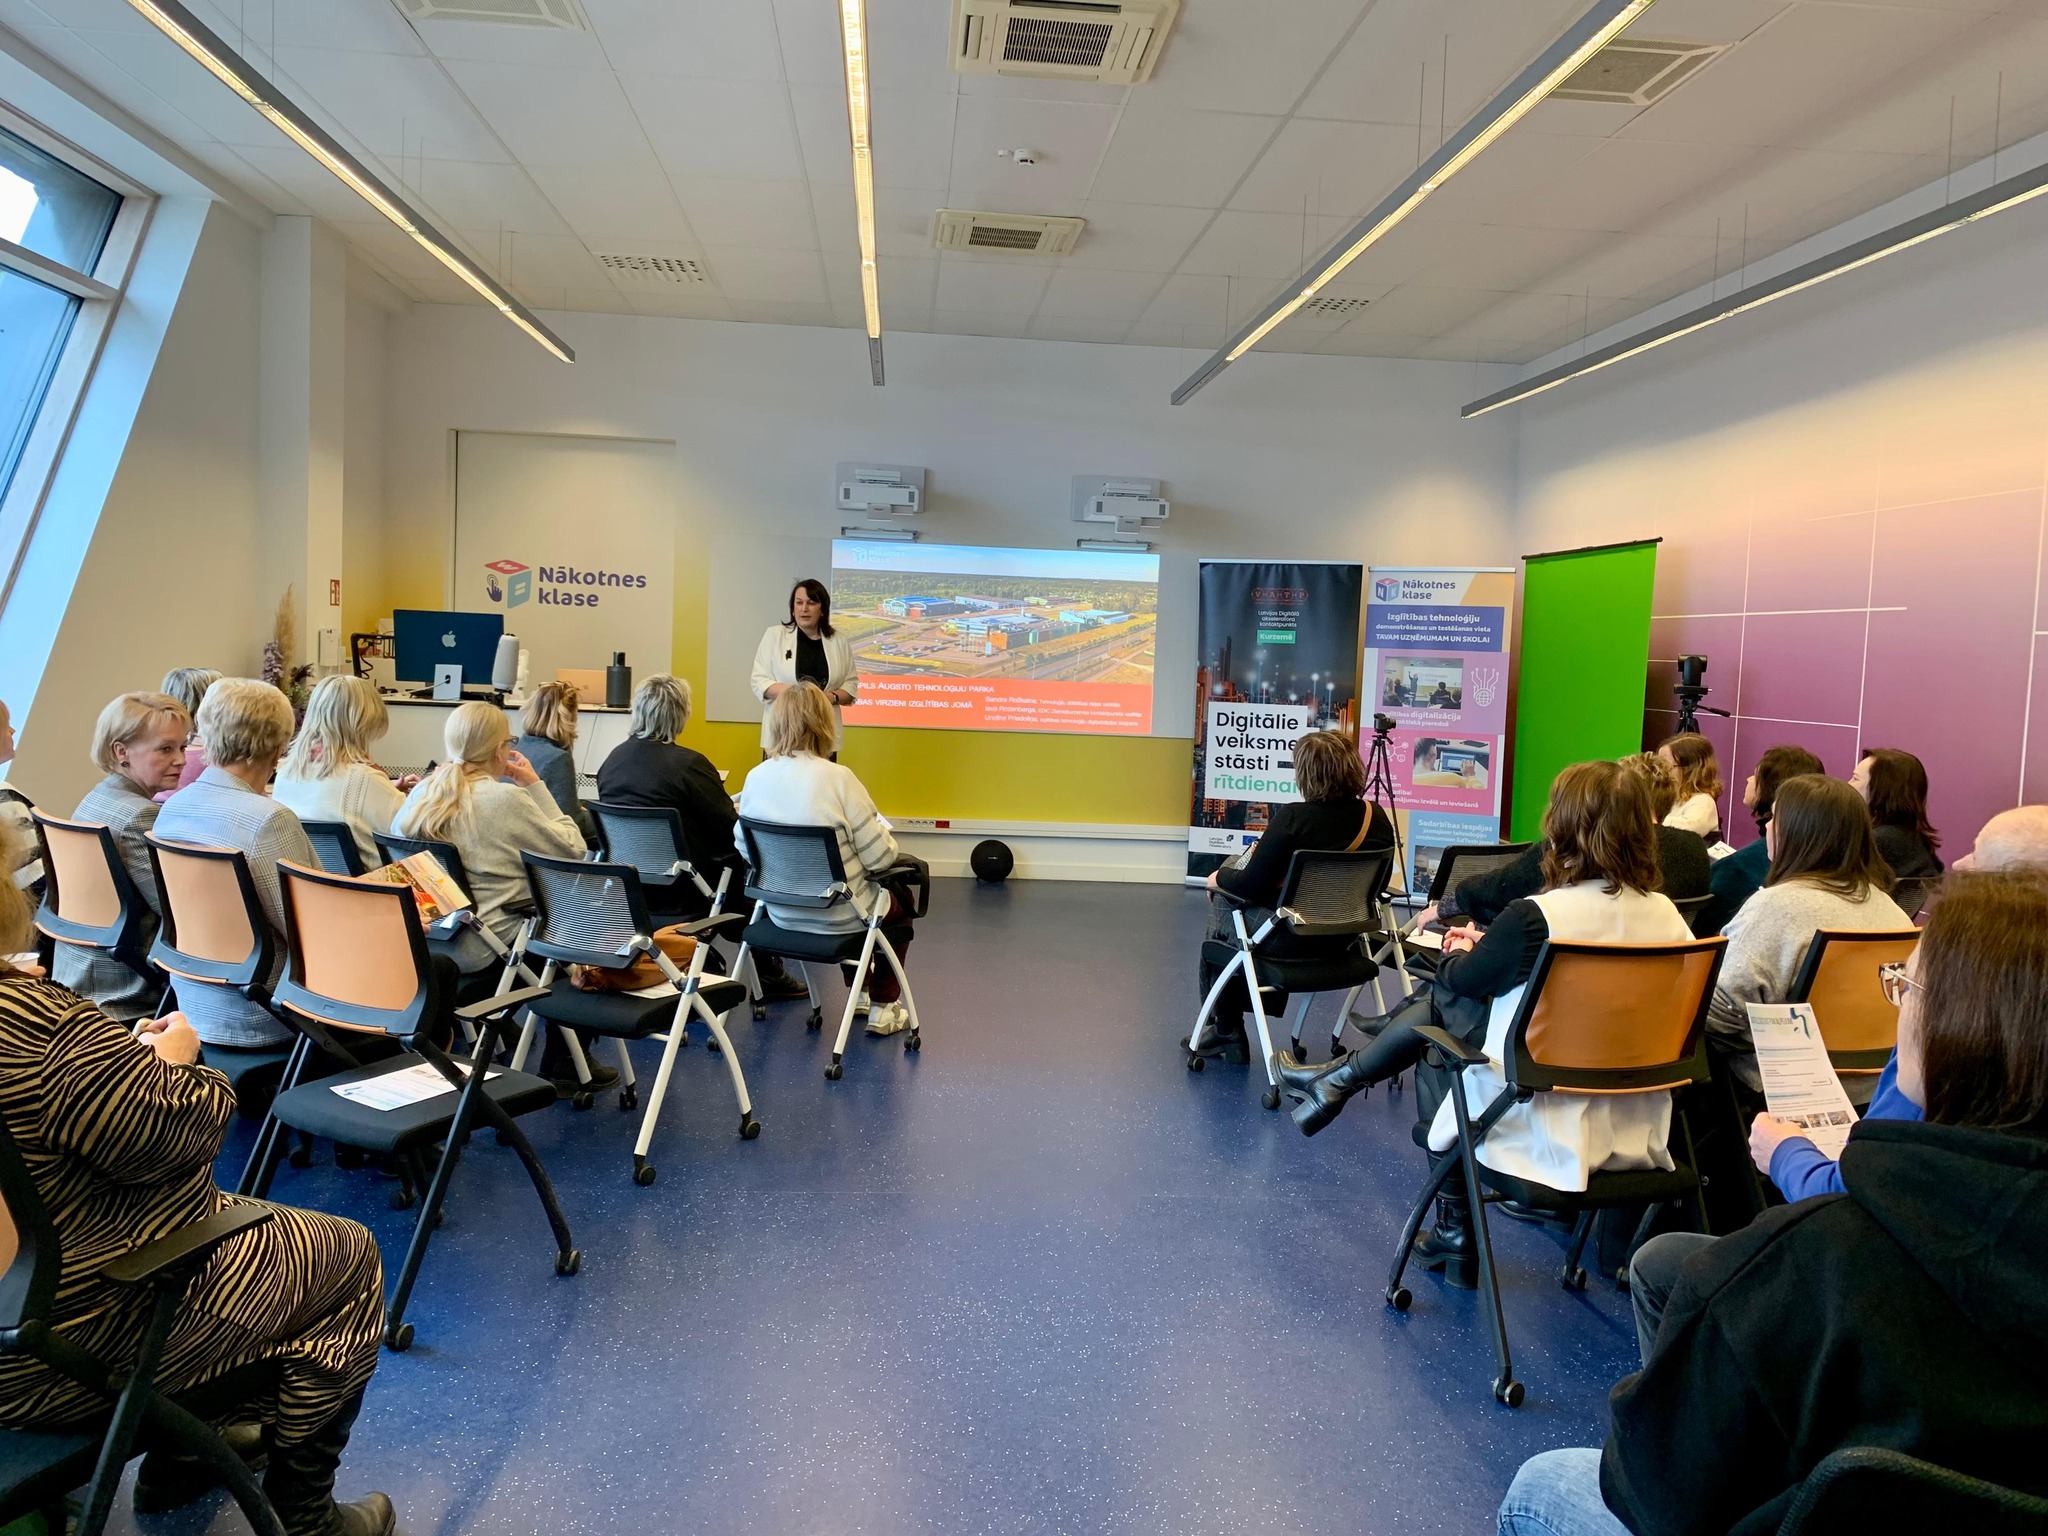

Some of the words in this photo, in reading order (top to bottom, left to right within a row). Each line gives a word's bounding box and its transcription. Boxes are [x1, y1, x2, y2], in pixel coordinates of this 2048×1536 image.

[539, 566, 647, 588] Nākotnes
[1402, 580, 1456, 590] Nākotnes
[538, 587, 599, 607] klase
[1402, 590, 1432, 600] klase
[1387, 612, 1428, 622] Izglītības
[1429, 614, 1480, 624] tehnoloģiju
[1375, 623, 1427, 631] demonstrēšanas
[1260, 633, 1293, 641] Kurzemē
[1400, 633, 1450, 642] UZŅĒMUMAM
[914, 684, 967, 693] TEHNOLOĢIJU
[875, 699, 907, 707] VIRZIENI
[908, 699, 949, 708] IZGLĪTĪBAS
[950, 700, 973, 709] JOMĀ
[1216, 711, 1299, 732] Digitālie
[1410, 711, 1461, 722] digitalizācija
[1214, 754, 1270, 771] stāsti
[1418, 819, 1460, 829] Sadarbības
[1461, 823, 1493, 832] iespējas
